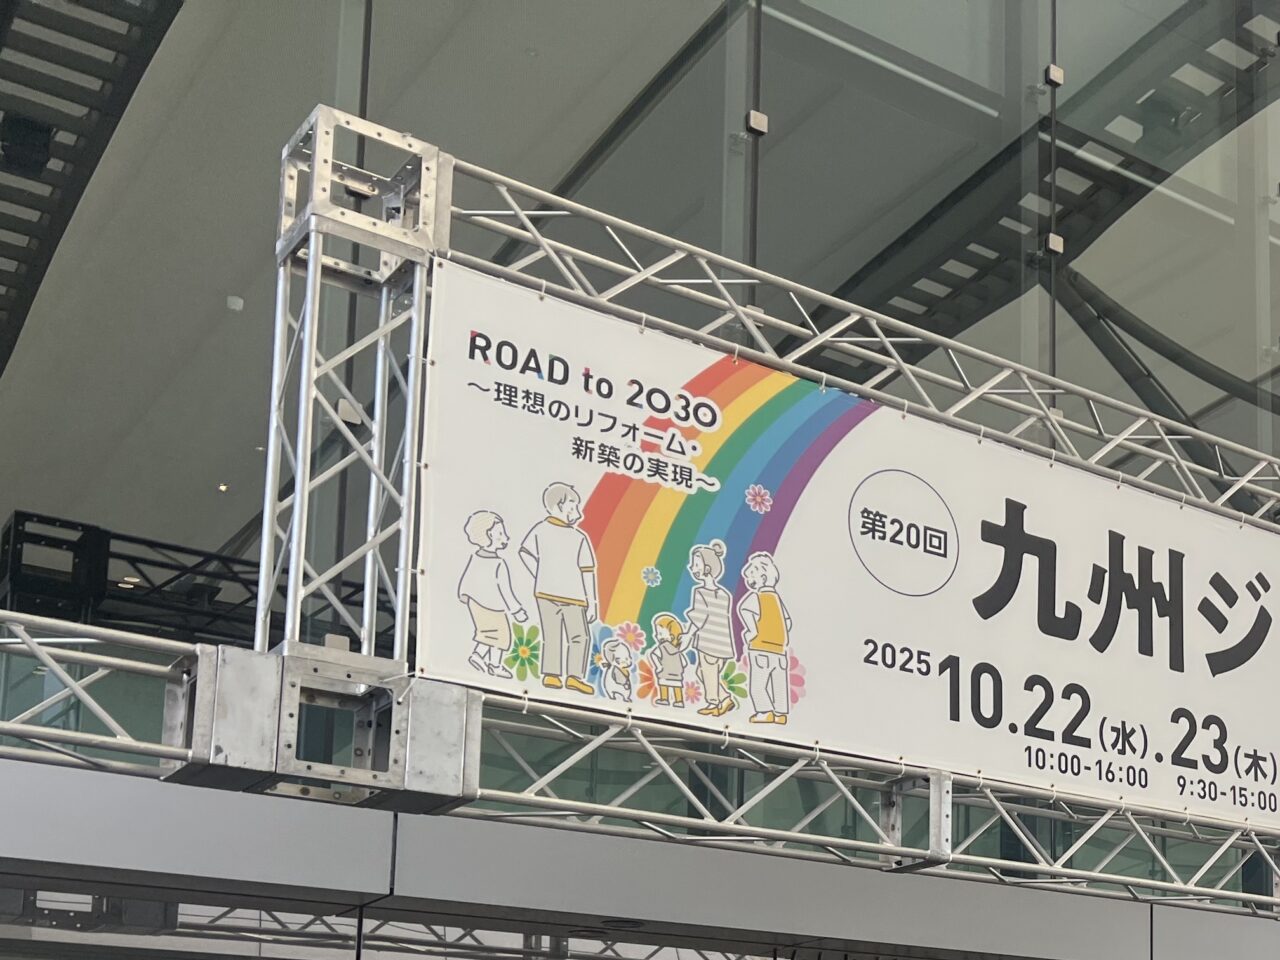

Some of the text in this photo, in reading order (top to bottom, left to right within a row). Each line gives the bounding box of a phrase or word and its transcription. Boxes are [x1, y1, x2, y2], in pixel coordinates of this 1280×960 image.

[468, 330, 718, 428] ROAD to 2030
[860, 507, 948, 558] 第20回
[863, 638, 932, 677] 2025
[1024, 746, 1278, 813] 10:00-16:00 9:30-15:00
